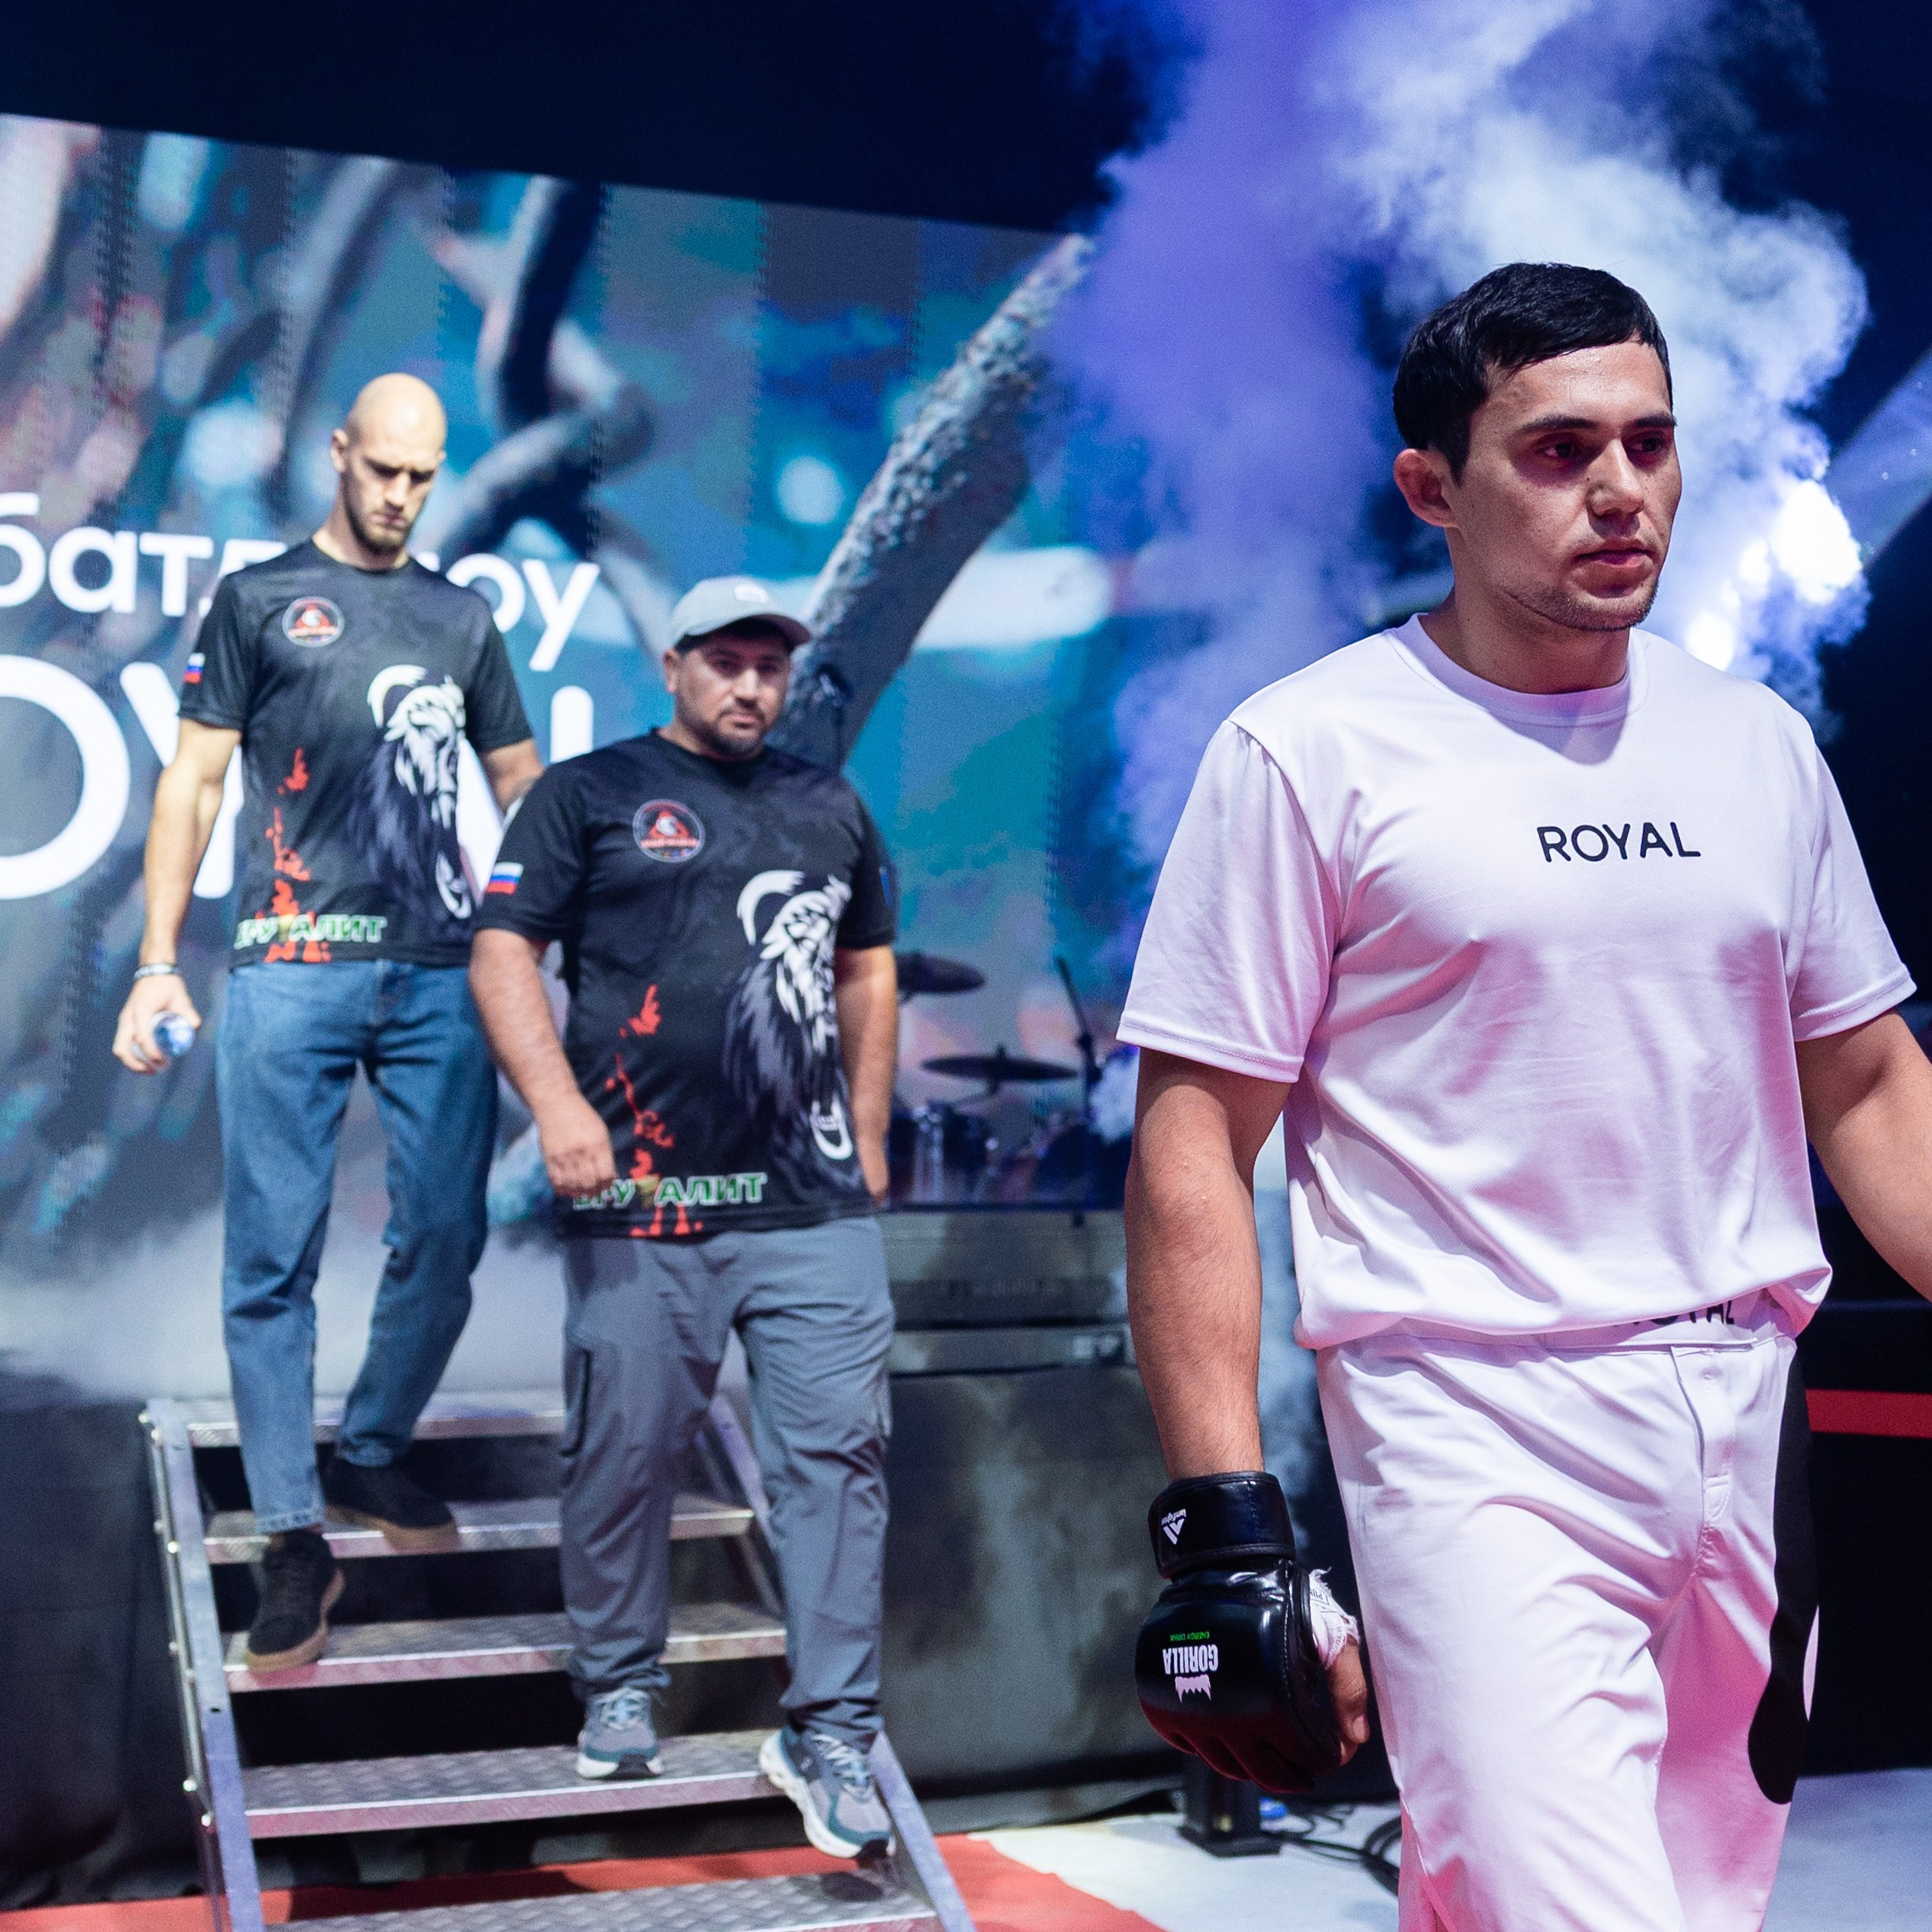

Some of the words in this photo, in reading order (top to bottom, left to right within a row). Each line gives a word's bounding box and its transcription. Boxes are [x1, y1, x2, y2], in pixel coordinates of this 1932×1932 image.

[411, 552, 601, 672] оу
[1537, 821, 1701, 863] ROYAL
[1162, 1644, 1219, 1675] GORILLA
